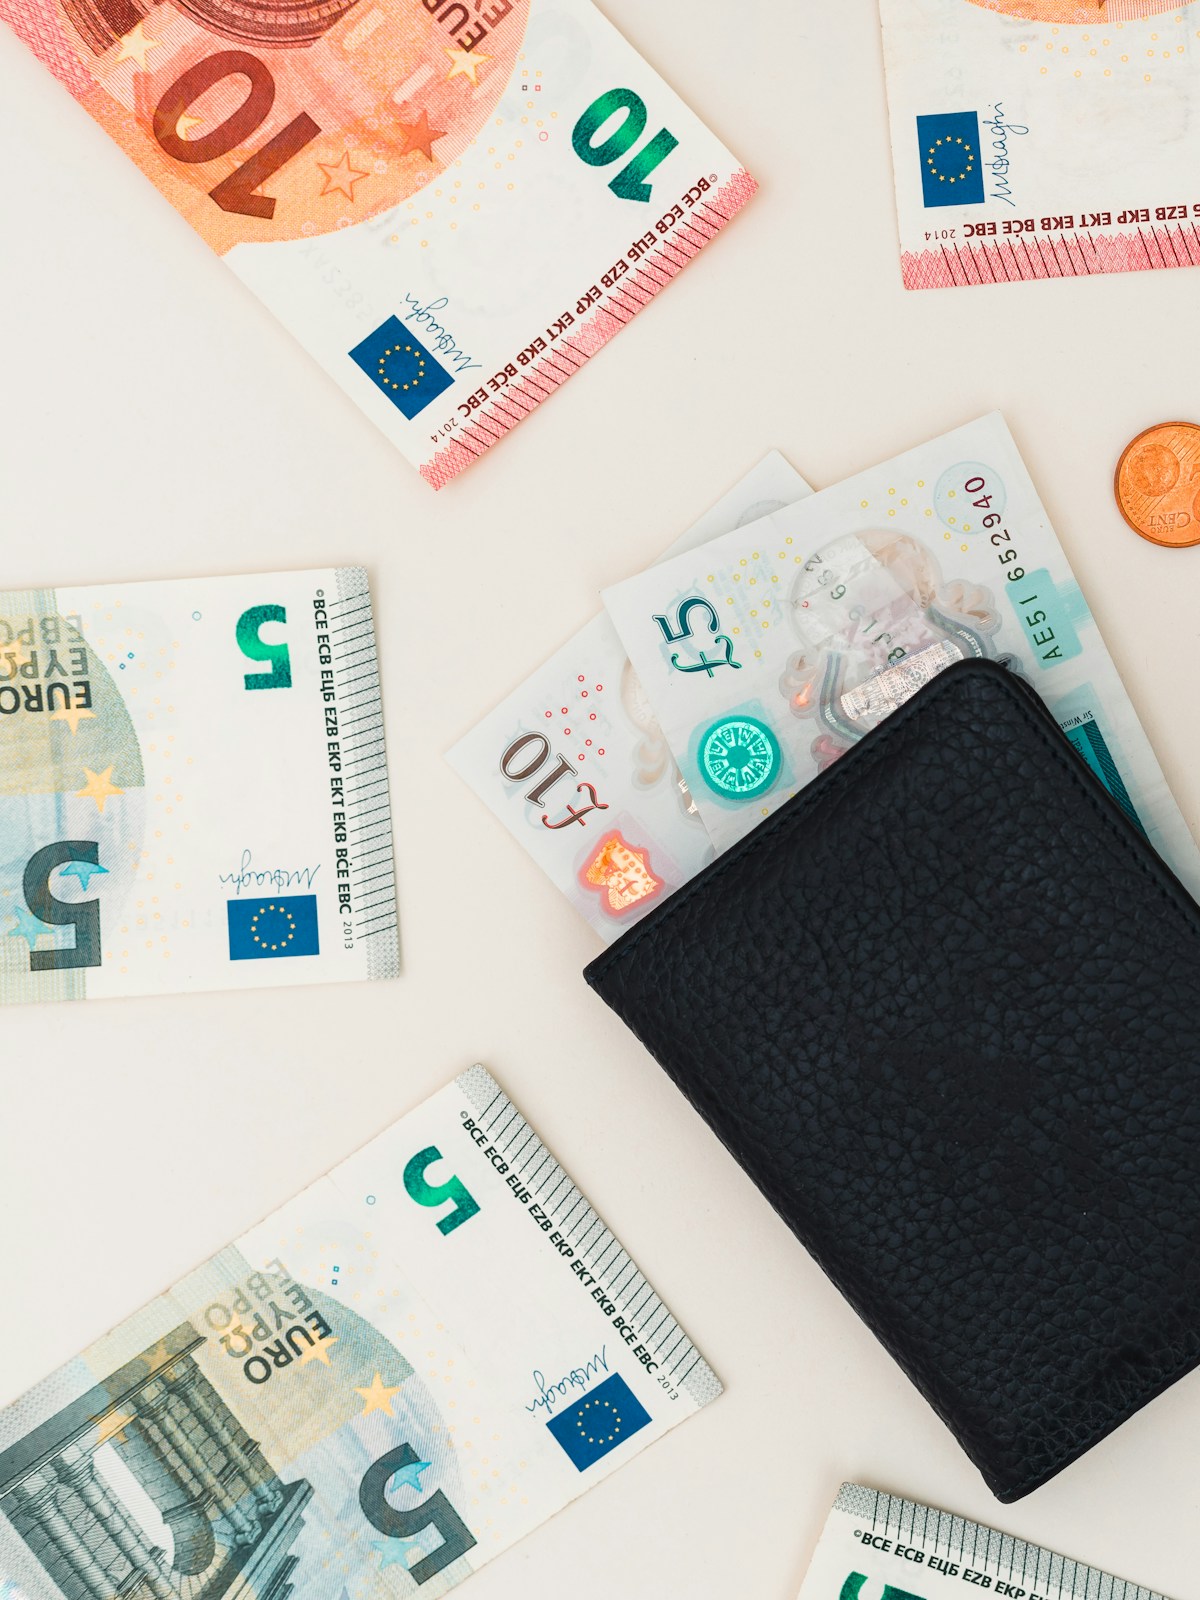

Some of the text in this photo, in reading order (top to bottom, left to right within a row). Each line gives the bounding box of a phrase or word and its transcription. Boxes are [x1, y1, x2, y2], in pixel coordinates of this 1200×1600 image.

[153, 50, 322, 219] 10
[572, 88, 679, 202] 10
[655, 203, 685, 234] ECB
[1040, 215, 1075, 231] EKB
[1116, 208, 1151, 225] EKP
[1154, 204, 1188, 221] EZB
[924, 229, 956, 241] 2014
[963, 221, 998, 238] EBC
[600, 258, 630, 289] EZB
[575, 284, 604, 315] EKP
[516, 336, 548, 367] EKB
[457, 386, 490, 418] EBC
[430, 417, 459, 443] 2014
[965, 476, 1025, 581] 652940
[1147, 512, 1191, 528] CENT
[1150, 524, 1175, 534] EURO
[236, 604, 292, 690] 5
[316, 634, 332, 666] ECB
[652, 596, 743, 678] £5
[0, 681, 92, 714] EURO
[324, 706, 339, 737] EZB
[327, 741, 342, 773] EKP
[500, 731, 609, 830] £10
[333, 811, 347, 843] EKB
[23, 840, 102, 971] 5
[337, 883, 352, 915] EBC
[343, 921, 354, 950] 2013
[403, 1145, 481, 1236] 5
[483, 1145, 510, 1175] ECB
[527, 1202, 554, 1232] EZB
[548, 1230, 575, 1258] EKP
[590, 1286, 617, 1317] EKB
[632, 1343, 659, 1375] EBC
[657, 1374, 679, 1401] 2013
[243, 1310, 332, 1384] EURO
[359, 1442, 478, 1585] 5
[893, 1543, 926, 1564] ECB
[961, 1567, 993, 1589] EZB
[993, 1579, 1026, 1600] EKP
